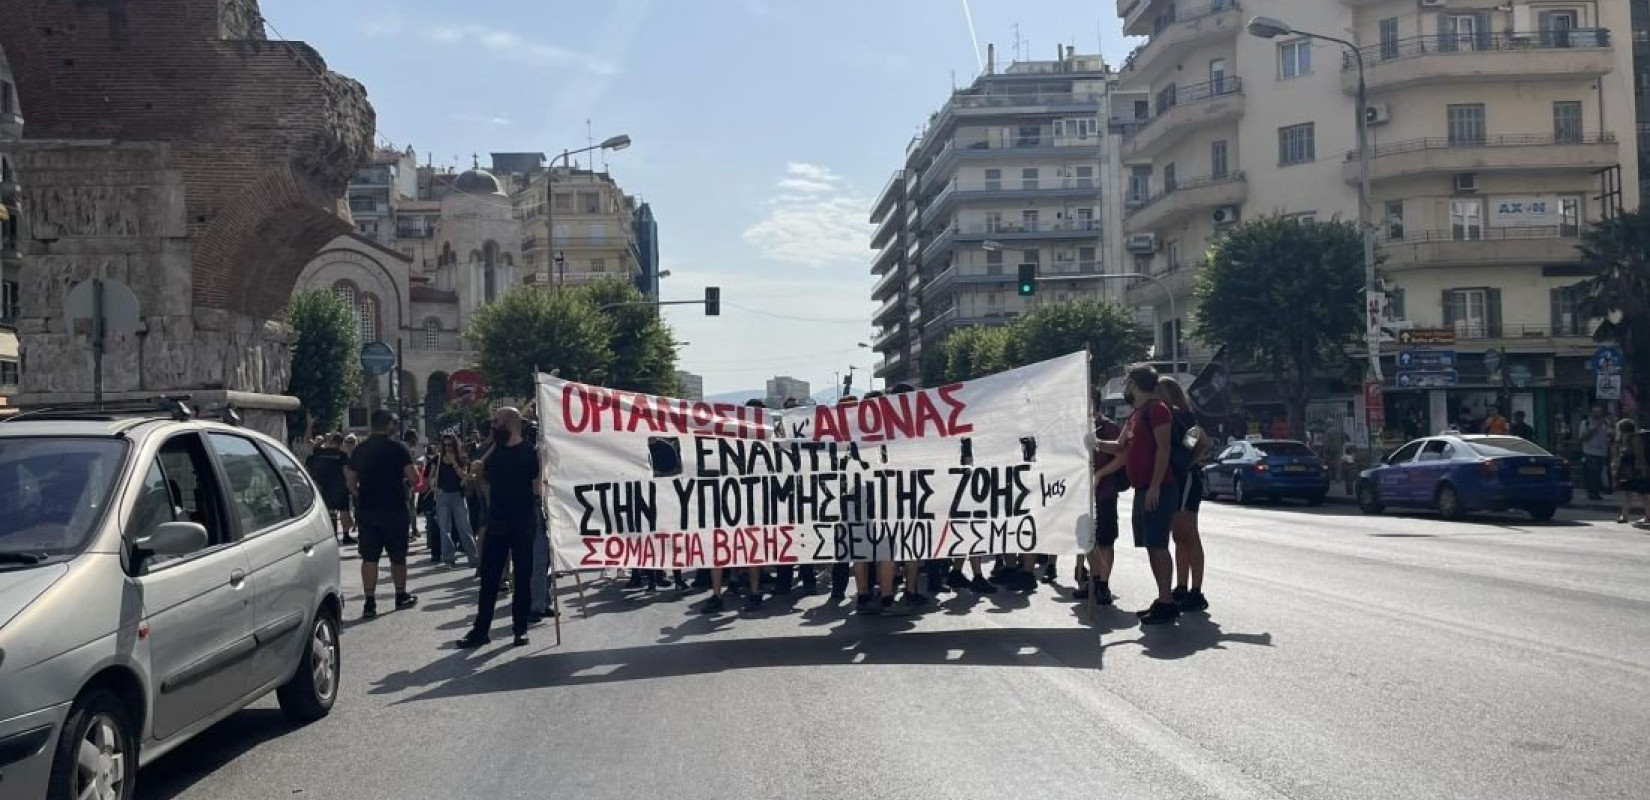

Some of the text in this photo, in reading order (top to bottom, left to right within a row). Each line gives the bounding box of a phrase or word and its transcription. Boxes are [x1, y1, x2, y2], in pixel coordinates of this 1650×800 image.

[562, 382, 767, 439] ΟΡΓΑΝΩΣΗ
[813, 384, 973, 442] ΑΓΩΝΑΣ
[695, 436, 870, 477] ΕΝΑΝΤΙΑ
[574, 464, 1067, 536] ΣΤΗΝ ΥΠΟΤΙΜΗΣΗ ΤΗΣ ΖΩΗΣ μας
[580, 531, 705, 567] ΣΩΜΑΤΕΙΑ
